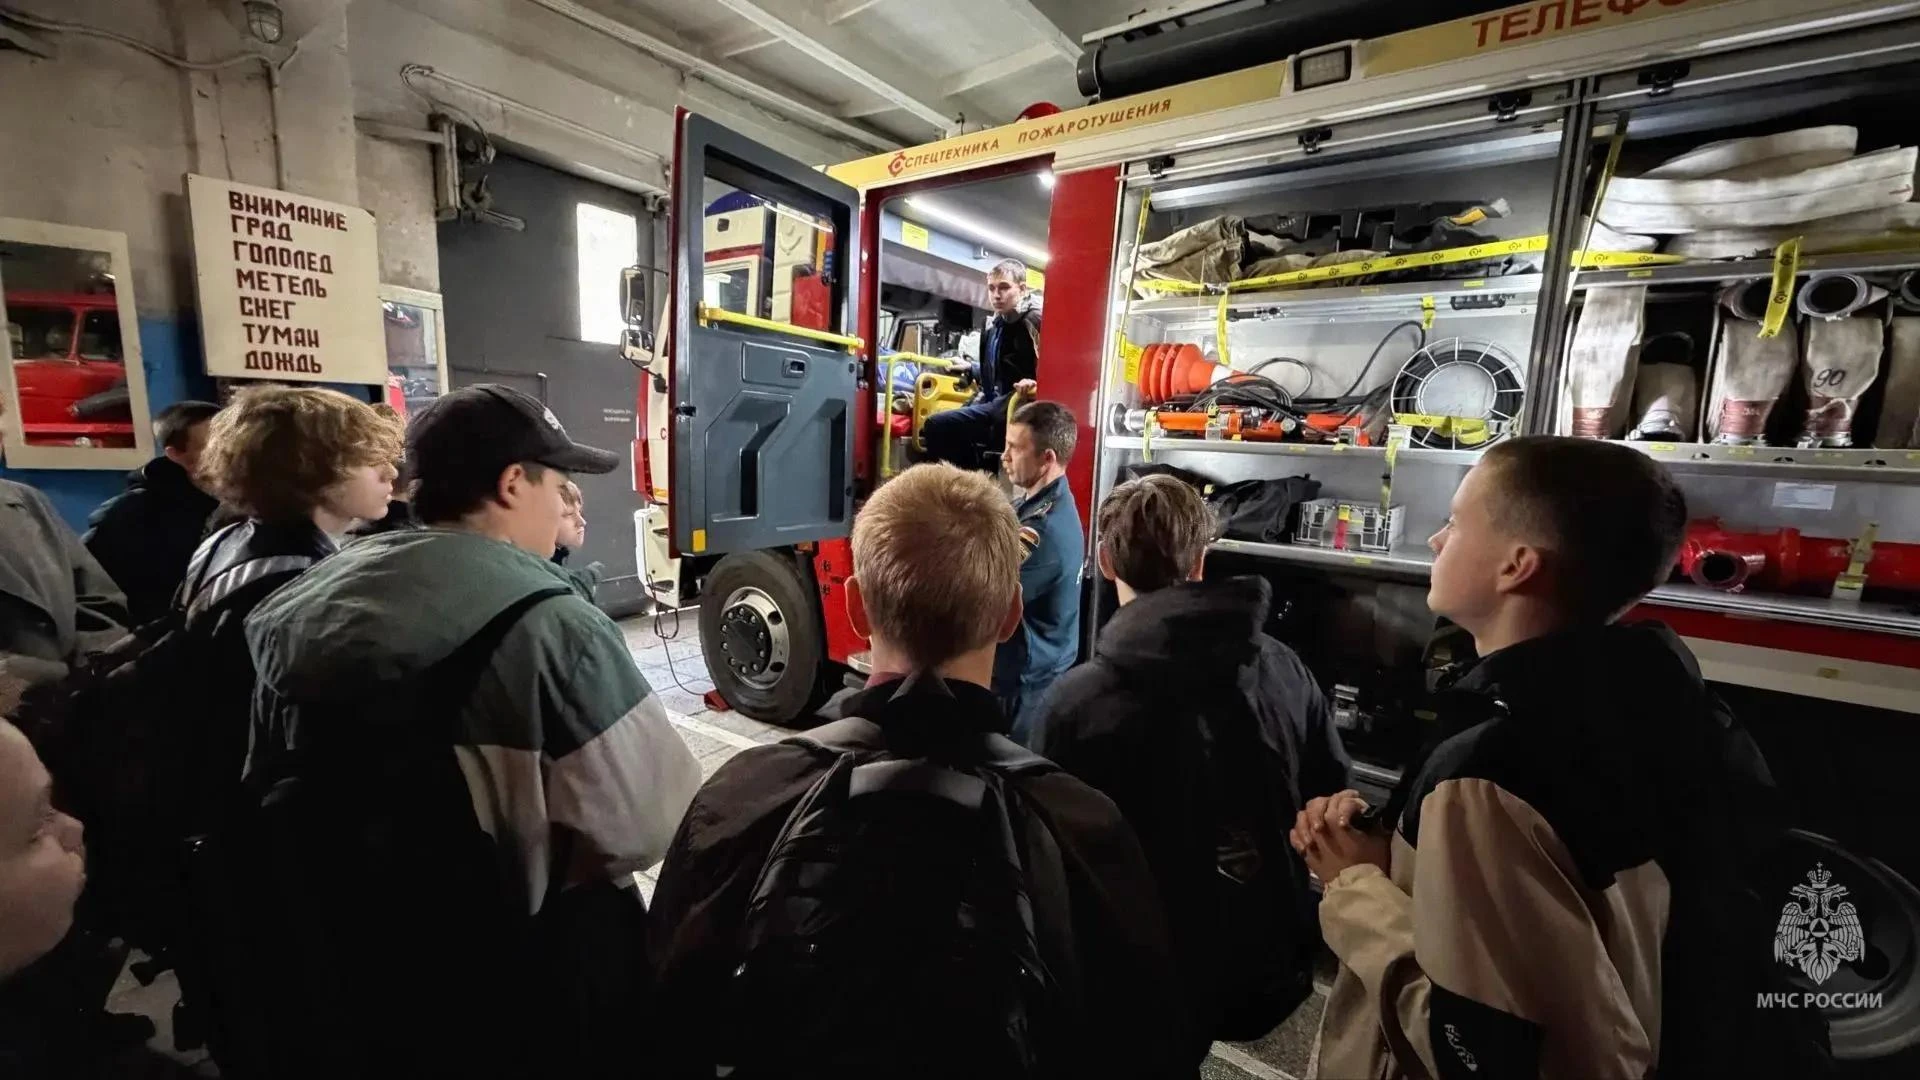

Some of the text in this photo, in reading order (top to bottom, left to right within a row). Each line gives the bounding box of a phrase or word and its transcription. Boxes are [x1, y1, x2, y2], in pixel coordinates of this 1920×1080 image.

[904, 98, 1172, 169] СПЕЦТЕХНИКА ПОЖАРОТУШЕНИЯ
[228, 190, 348, 232] ВНИМАНИЕ
[231, 214, 294, 242] ГРАД
[233, 240, 334, 275] ГОЛОЛЕД
[236, 268, 327, 298] МЕТЕЛЬ
[240, 296, 296, 320] СНЕГ
[242, 323, 319, 348] ТУМАН
[245, 350, 322, 374] ДОЖДЬ
[1813, 368, 1846, 388] 90
